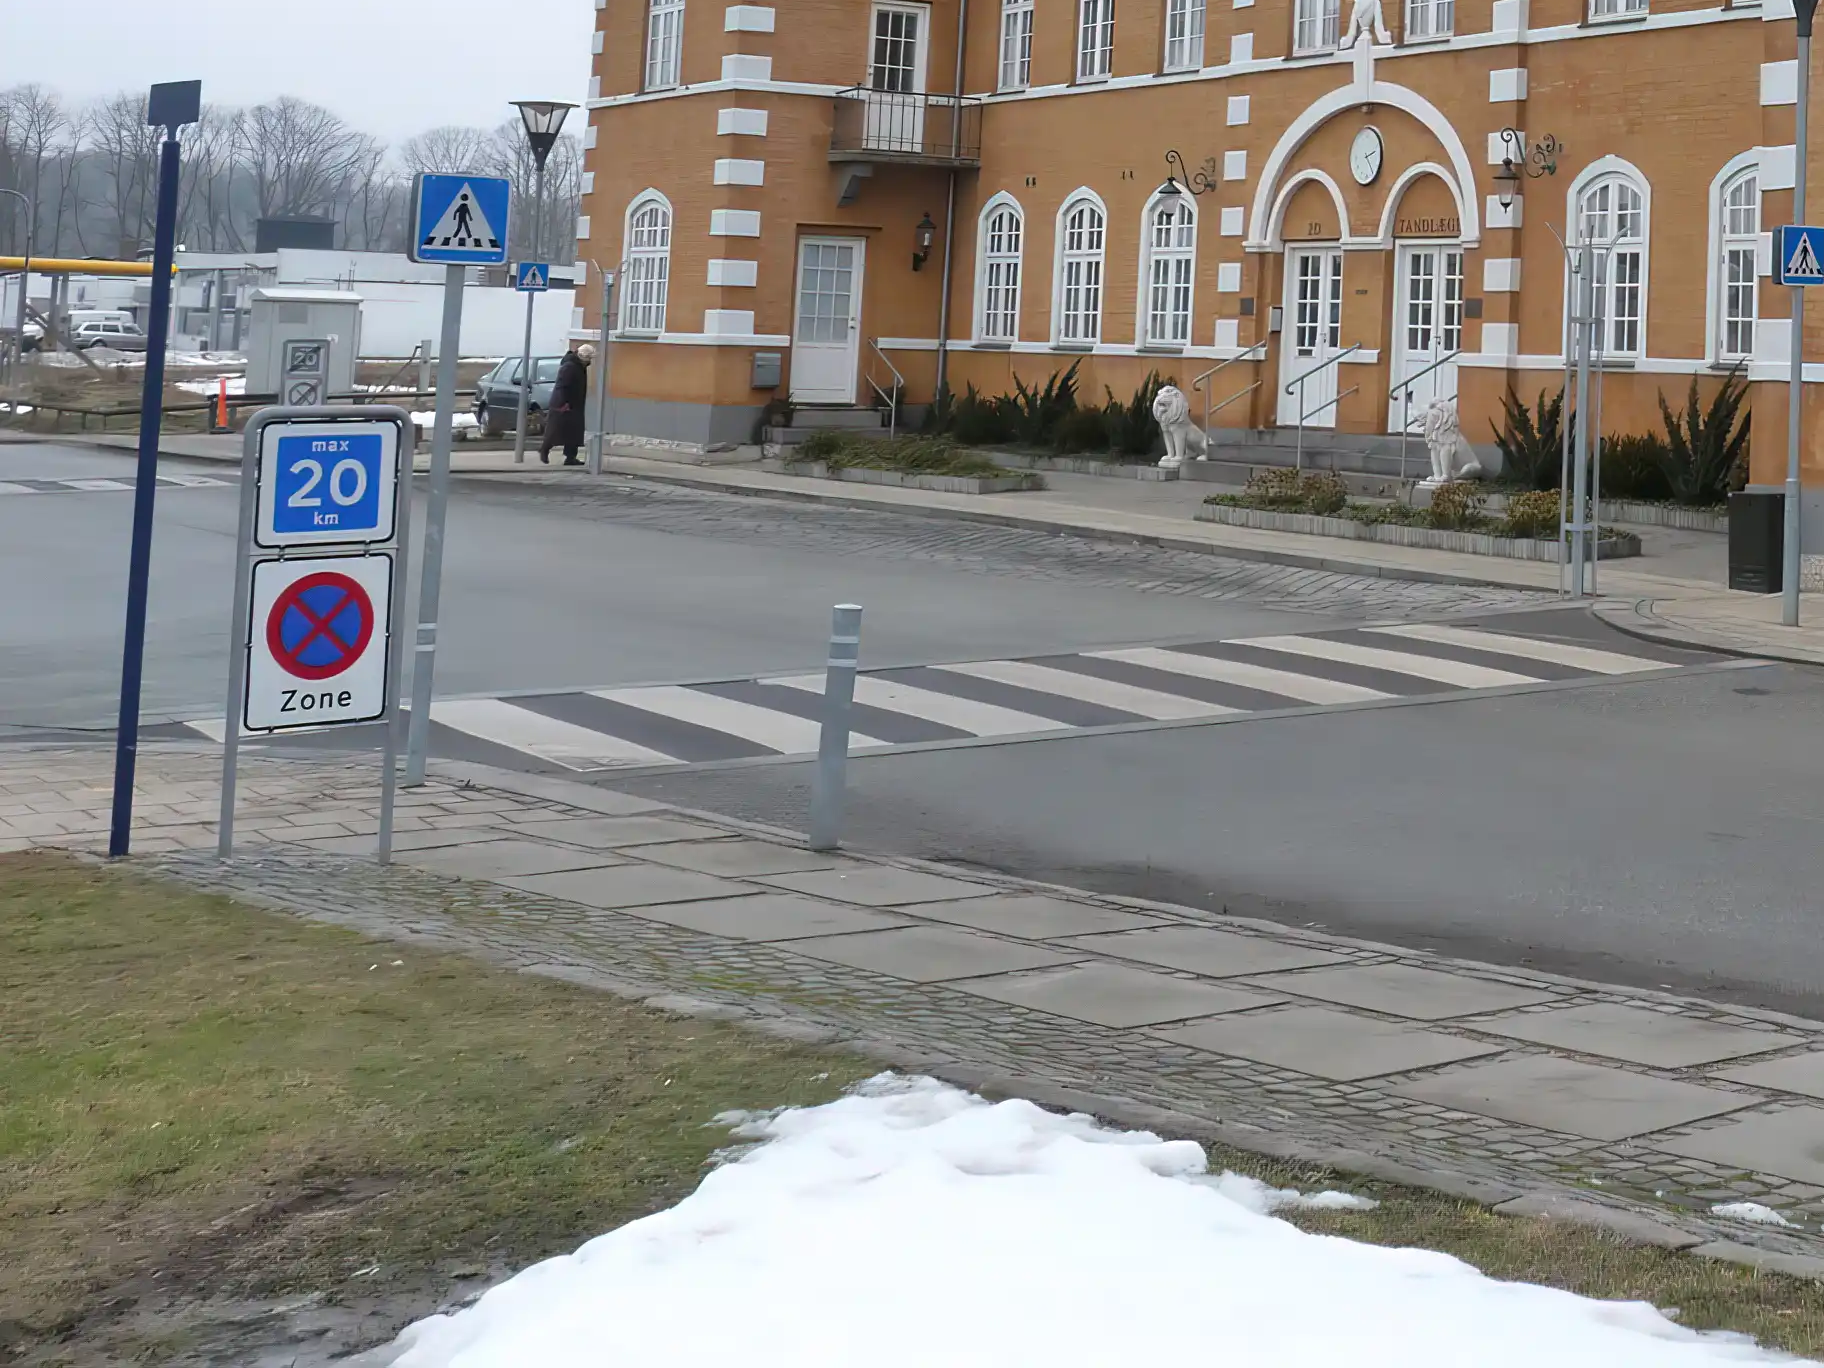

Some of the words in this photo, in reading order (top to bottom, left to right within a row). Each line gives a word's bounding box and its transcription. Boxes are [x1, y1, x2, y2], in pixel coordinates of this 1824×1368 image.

[312, 440, 350, 452] max
[288, 458, 367, 507] 20
[313, 512, 339, 525] km
[280, 689, 352, 713] Zone
